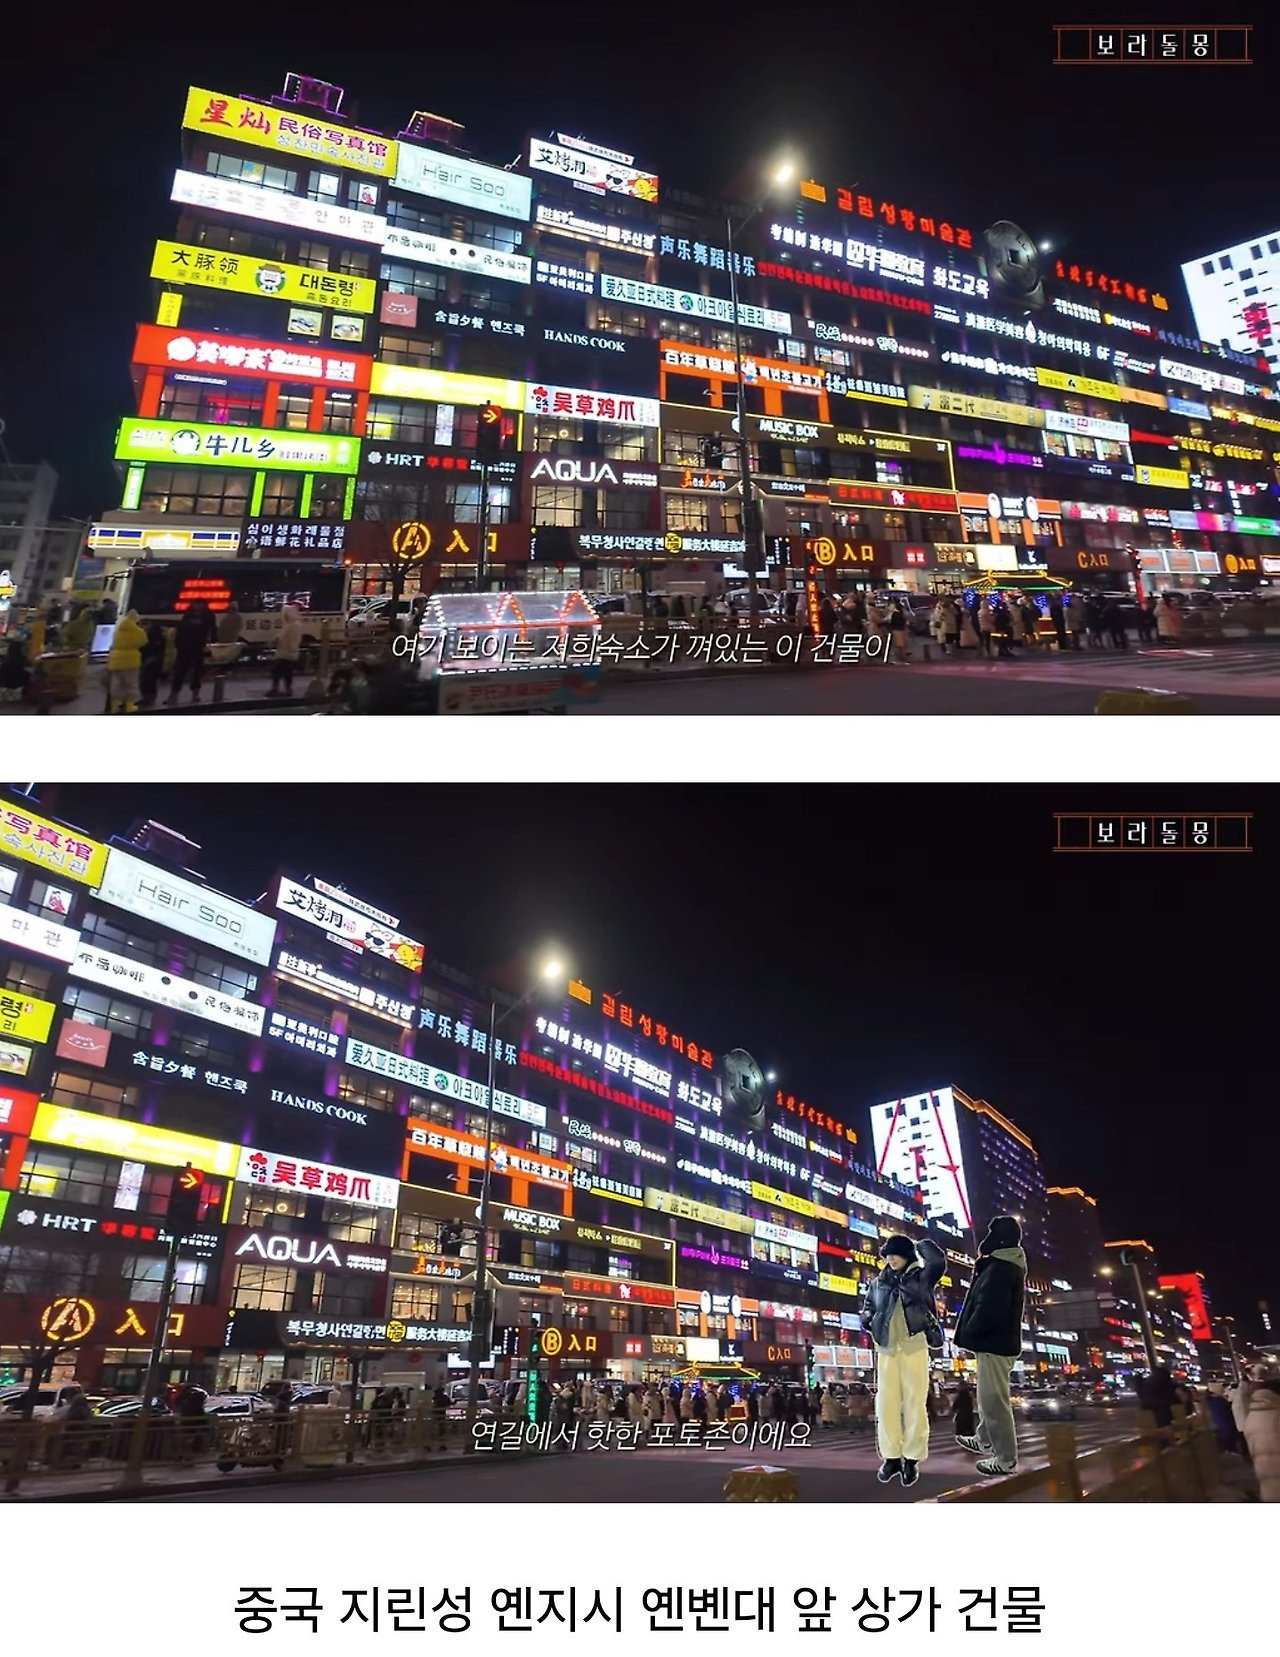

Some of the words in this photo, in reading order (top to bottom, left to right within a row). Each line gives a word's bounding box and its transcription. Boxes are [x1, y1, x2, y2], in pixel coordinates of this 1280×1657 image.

[278, 116, 388, 158] 民俗写真馆
[422, 164, 462, 186] Hair
[469, 176, 505, 198] Soo
[171, 249, 240, 276] 大豚领
[299, 272, 354, 297] 대돈령
[544, 329, 589, 348] HANDS
[589, 336, 627, 354] COOK
[553, 390, 637, 422] 吴草鸡爪
[758, 418, 790, 436] MUSIC
[791, 421, 820, 439] BOX
[205, 434, 277, 459] 牛儿乡
[384, 452, 425, 468] HRT
[529, 457, 620, 485] AQUA
[842, 544, 875, 562] 入口
[137, 880, 190, 910] Hair
[198, 904, 243, 934] Soo
[270, 1089, 325, 1115] HANDS
[325, 1105, 369, 1127] COOK
[271, 1159, 372, 1202] 吴草鸡爪
[42, 1213, 98, 1234] HRT
[235, 1233, 342, 1269] AQUA
[567, 1333, 598, 1351] 入口
